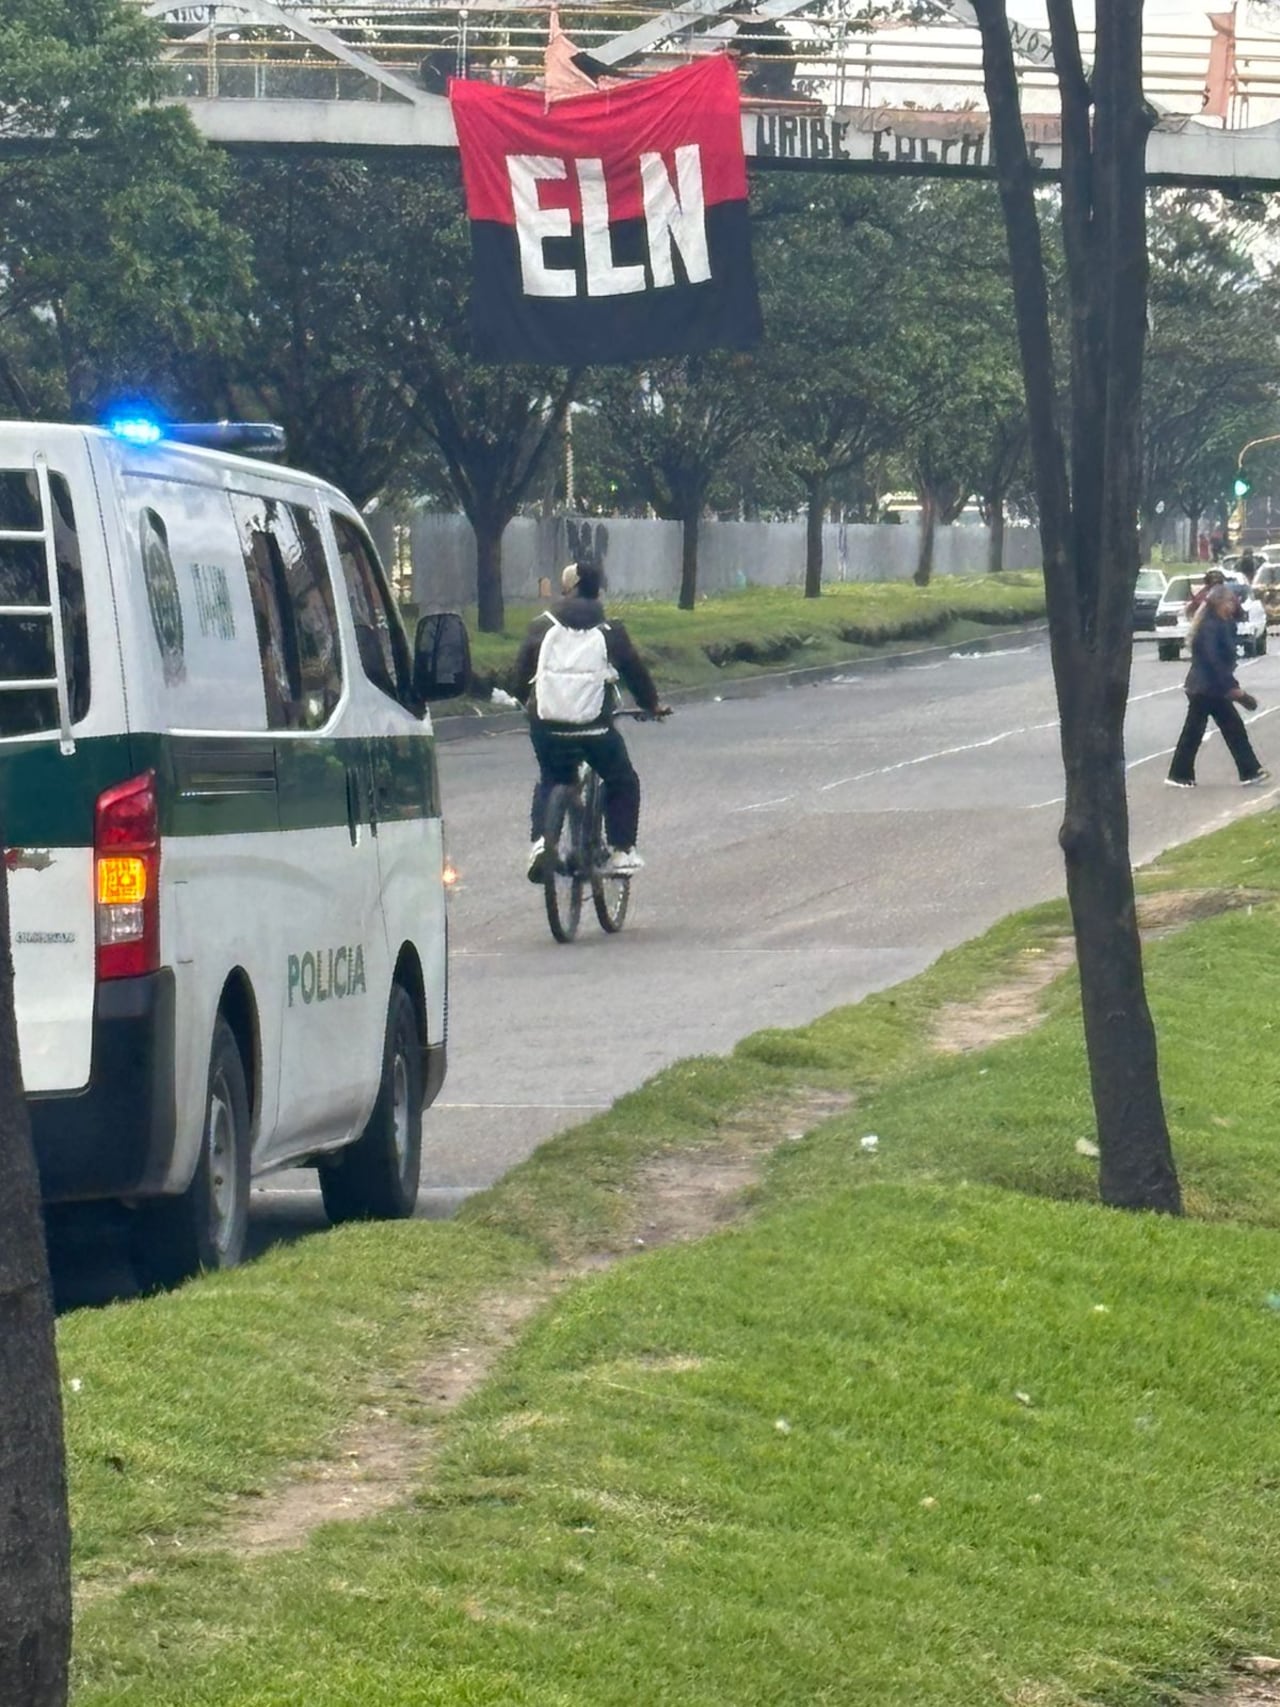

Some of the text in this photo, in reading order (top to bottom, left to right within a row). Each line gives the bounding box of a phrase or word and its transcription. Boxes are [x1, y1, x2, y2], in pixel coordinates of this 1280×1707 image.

[757, 113, 851, 158] URIBE
[505, 143, 712, 297] ELN
[287, 943, 366, 1007] POLICIA
